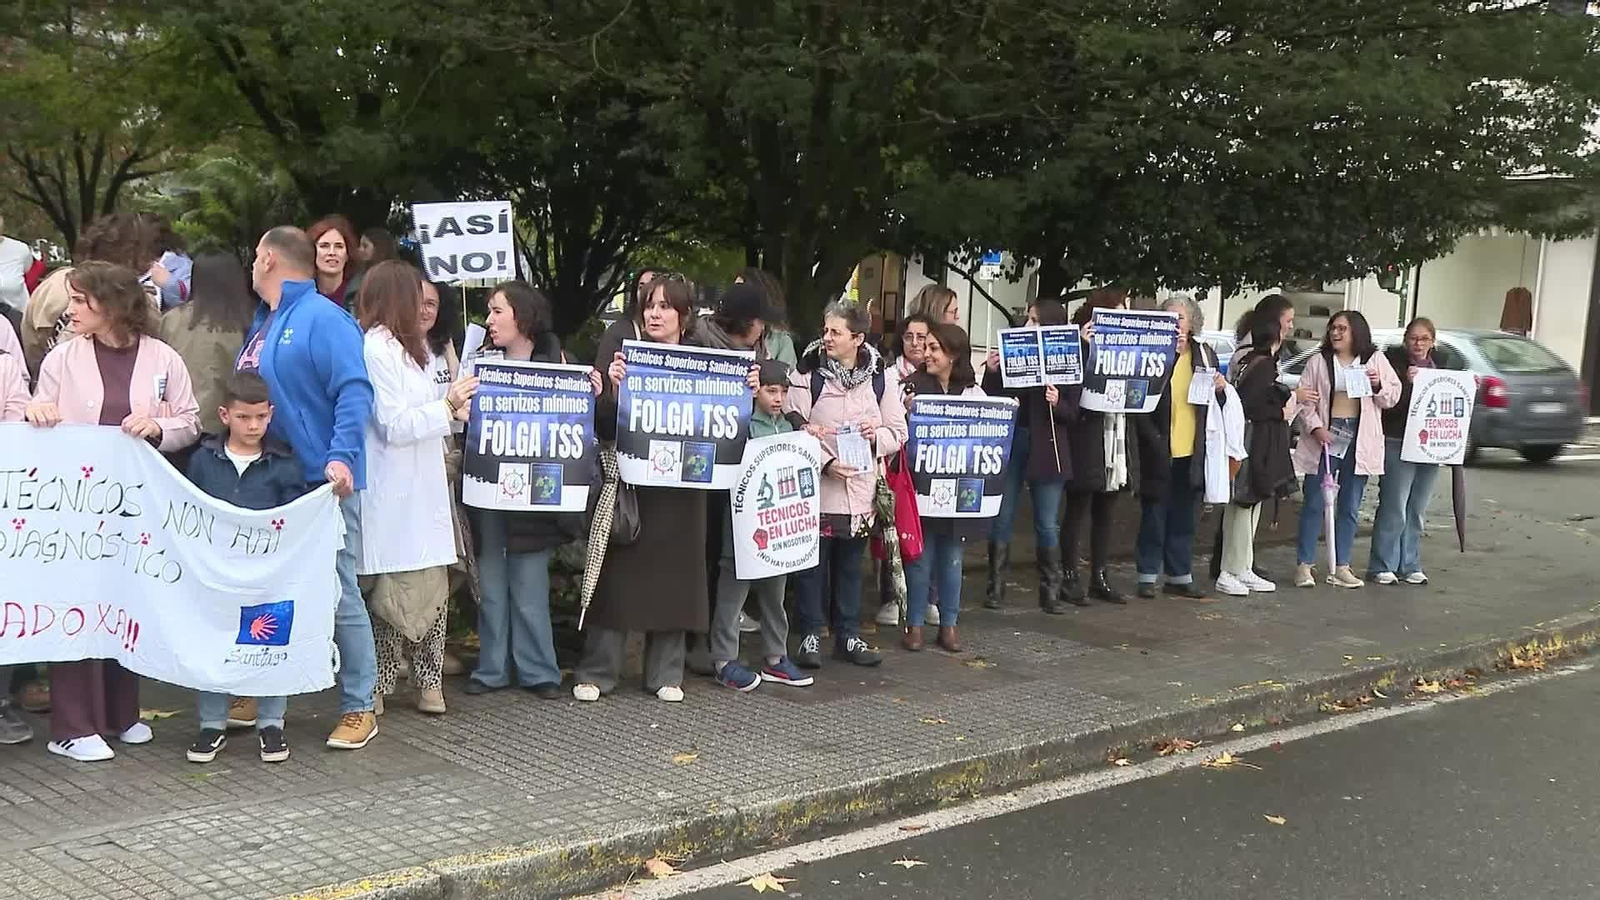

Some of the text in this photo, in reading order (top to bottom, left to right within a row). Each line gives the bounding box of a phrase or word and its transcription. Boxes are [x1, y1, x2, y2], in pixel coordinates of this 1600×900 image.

[419, 209, 509, 245] ¡ASÍ
[428, 250, 508, 277] NO!
[1096, 314, 1121, 325] Técnicos
[1094, 332, 1173, 346] en servizos mínimos
[627, 349, 749, 377] Técnicos Superiores Sanitarios
[1006, 354, 1039, 368] FOLGA TSS
[1046, 353, 1079, 367] FOLGA TSS
[1094, 349, 1167, 378] FOLGA TSS
[479, 367, 592, 393] Técnicos Superiores Sanitarios
[627, 373, 744, 397] en servizos mínimos
[479, 394, 588, 414] en servizos mínimos
[915, 402, 1013, 420] Técnicos Superiores Sanitarios
[629, 397, 740, 440] FOLGA TSS
[915, 421, 1009, 438] en servizos mínimos
[479, 418, 584, 460] FOLGA TSS
[1429, 429, 1462, 440] EN LUCHA
[914, 443, 1003, 475] FOLGA TSS
[733, 464, 756, 515] TÉCNICOS
[754, 443, 797, 467] SUPERIORES
[0, 467, 143, 518] TÉCNICOS
[162, 500, 215, 545] NON
[757, 500, 810, 527] TÉCNICOS
[768, 515, 818, 541] EN LUCHA
[772, 534, 812, 552] SIN NOSOTROS
[770, 559, 784, 568] HAY
[223, 647, 288, 667] Santiago
